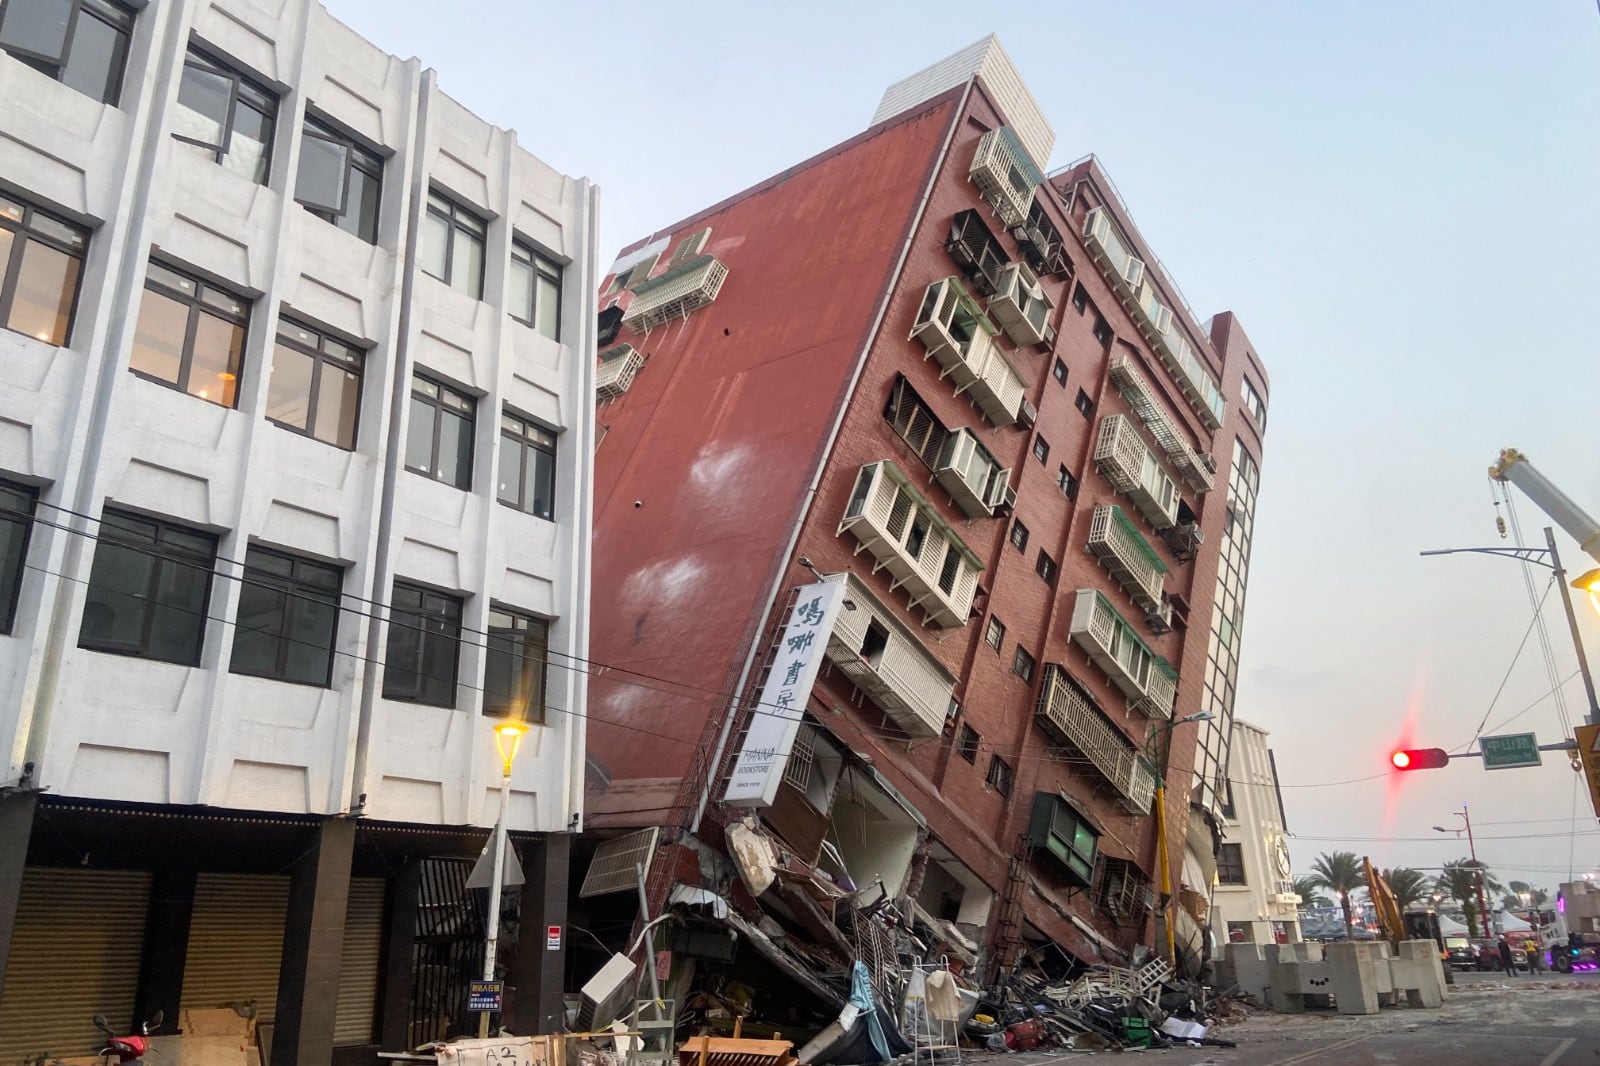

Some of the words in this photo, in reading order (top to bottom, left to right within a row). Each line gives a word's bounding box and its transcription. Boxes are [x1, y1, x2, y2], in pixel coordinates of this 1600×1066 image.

[1486, 736, 1531, 752] 中山路
[737, 764, 770, 775] BOOKSTORE
